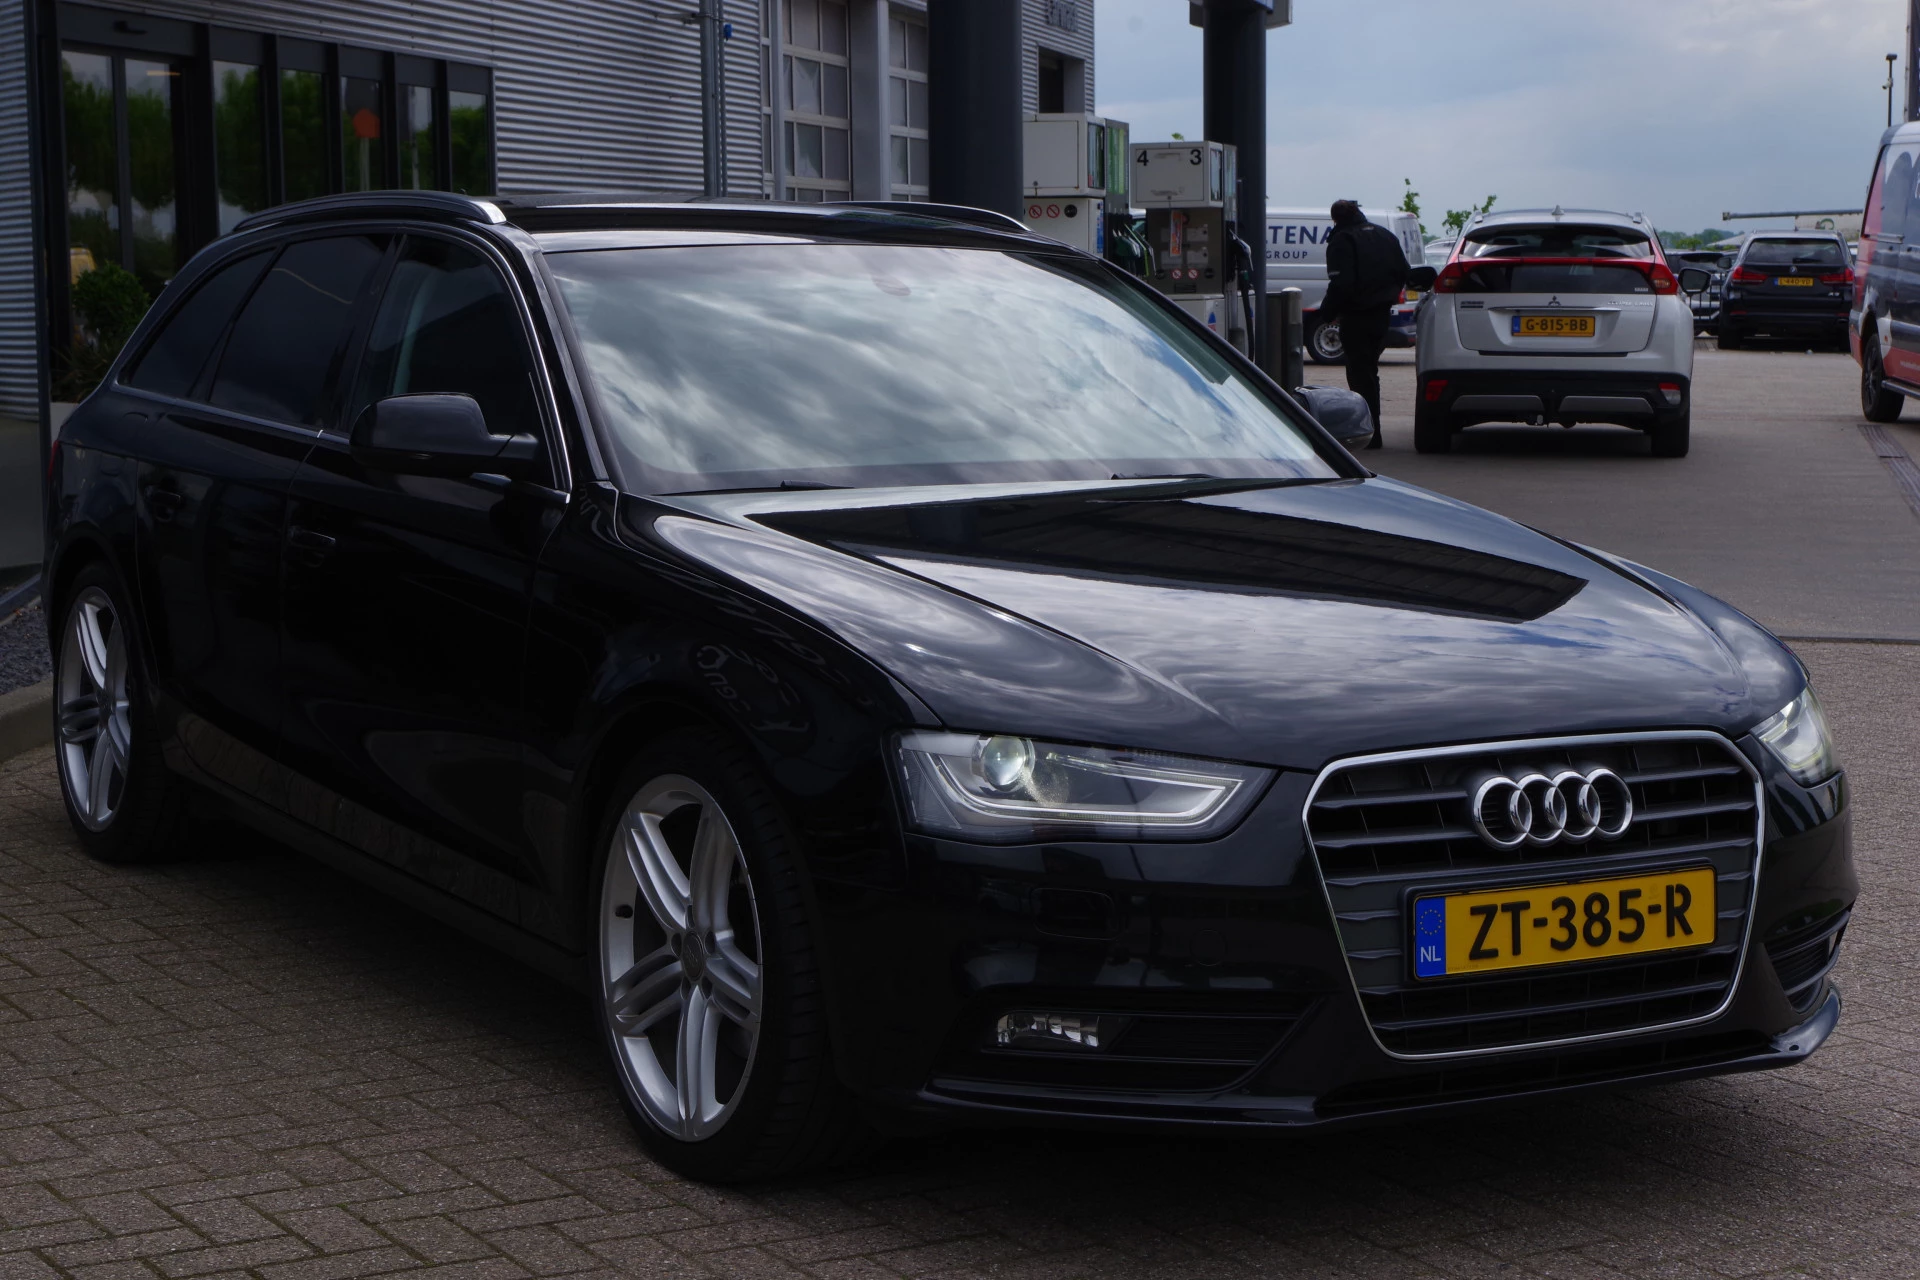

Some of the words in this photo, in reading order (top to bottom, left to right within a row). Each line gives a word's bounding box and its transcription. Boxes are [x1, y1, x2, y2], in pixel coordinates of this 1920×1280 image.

[1137, 150, 1149, 166] 4
[1190, 149, 1202, 165] 3
[1266, 250, 1308, 259] GROUP
[1526, 318, 1588, 331] G-815-BB
[1468, 883, 1693, 960] ZT-385-R
[1420, 945, 1441, 963] NL
